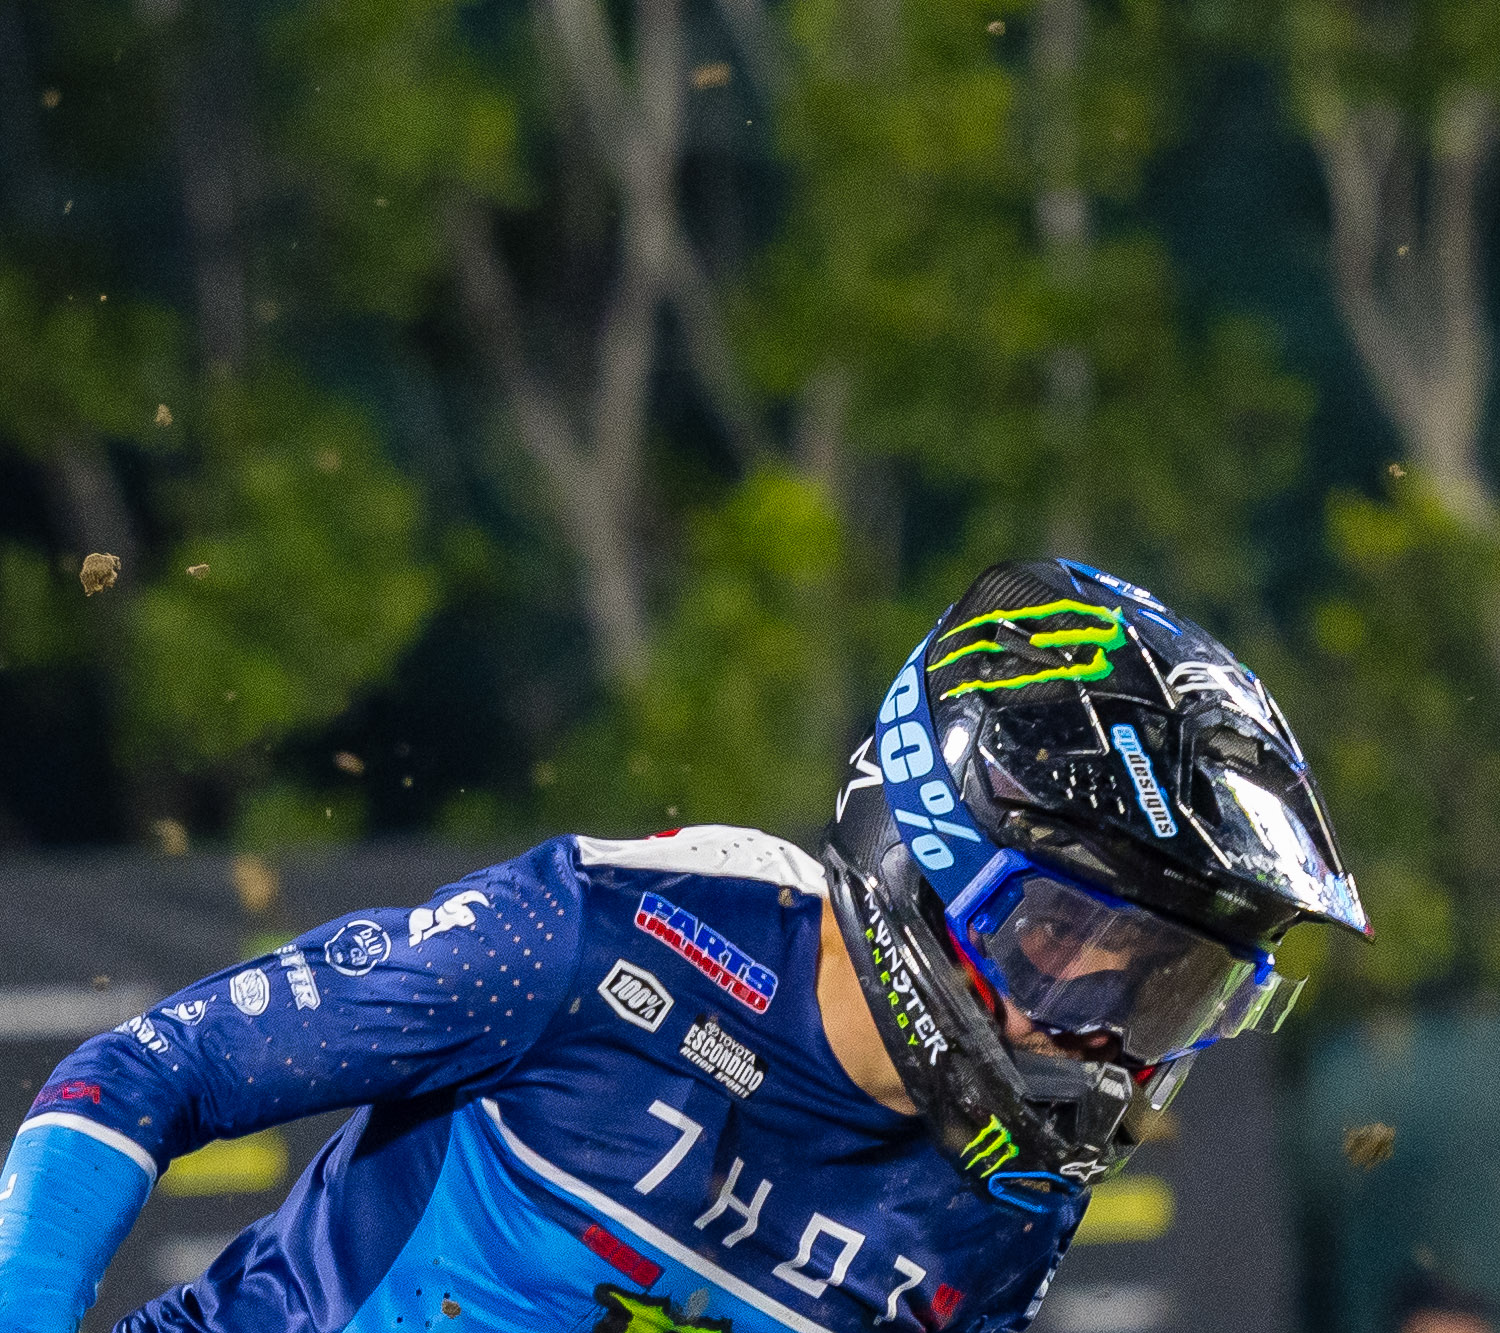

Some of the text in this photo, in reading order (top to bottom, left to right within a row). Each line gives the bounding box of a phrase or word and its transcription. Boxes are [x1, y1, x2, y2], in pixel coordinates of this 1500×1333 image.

[635, 911, 768, 1013] UNLIMITED
[640, 892, 778, 998] PARTS
[865, 891, 949, 1066] MONSTER
[610, 973, 667, 1021] 100%
[683, 1023, 765, 1092] ESCONDIDO
[718, 1031, 756, 1066] TOYOTA
